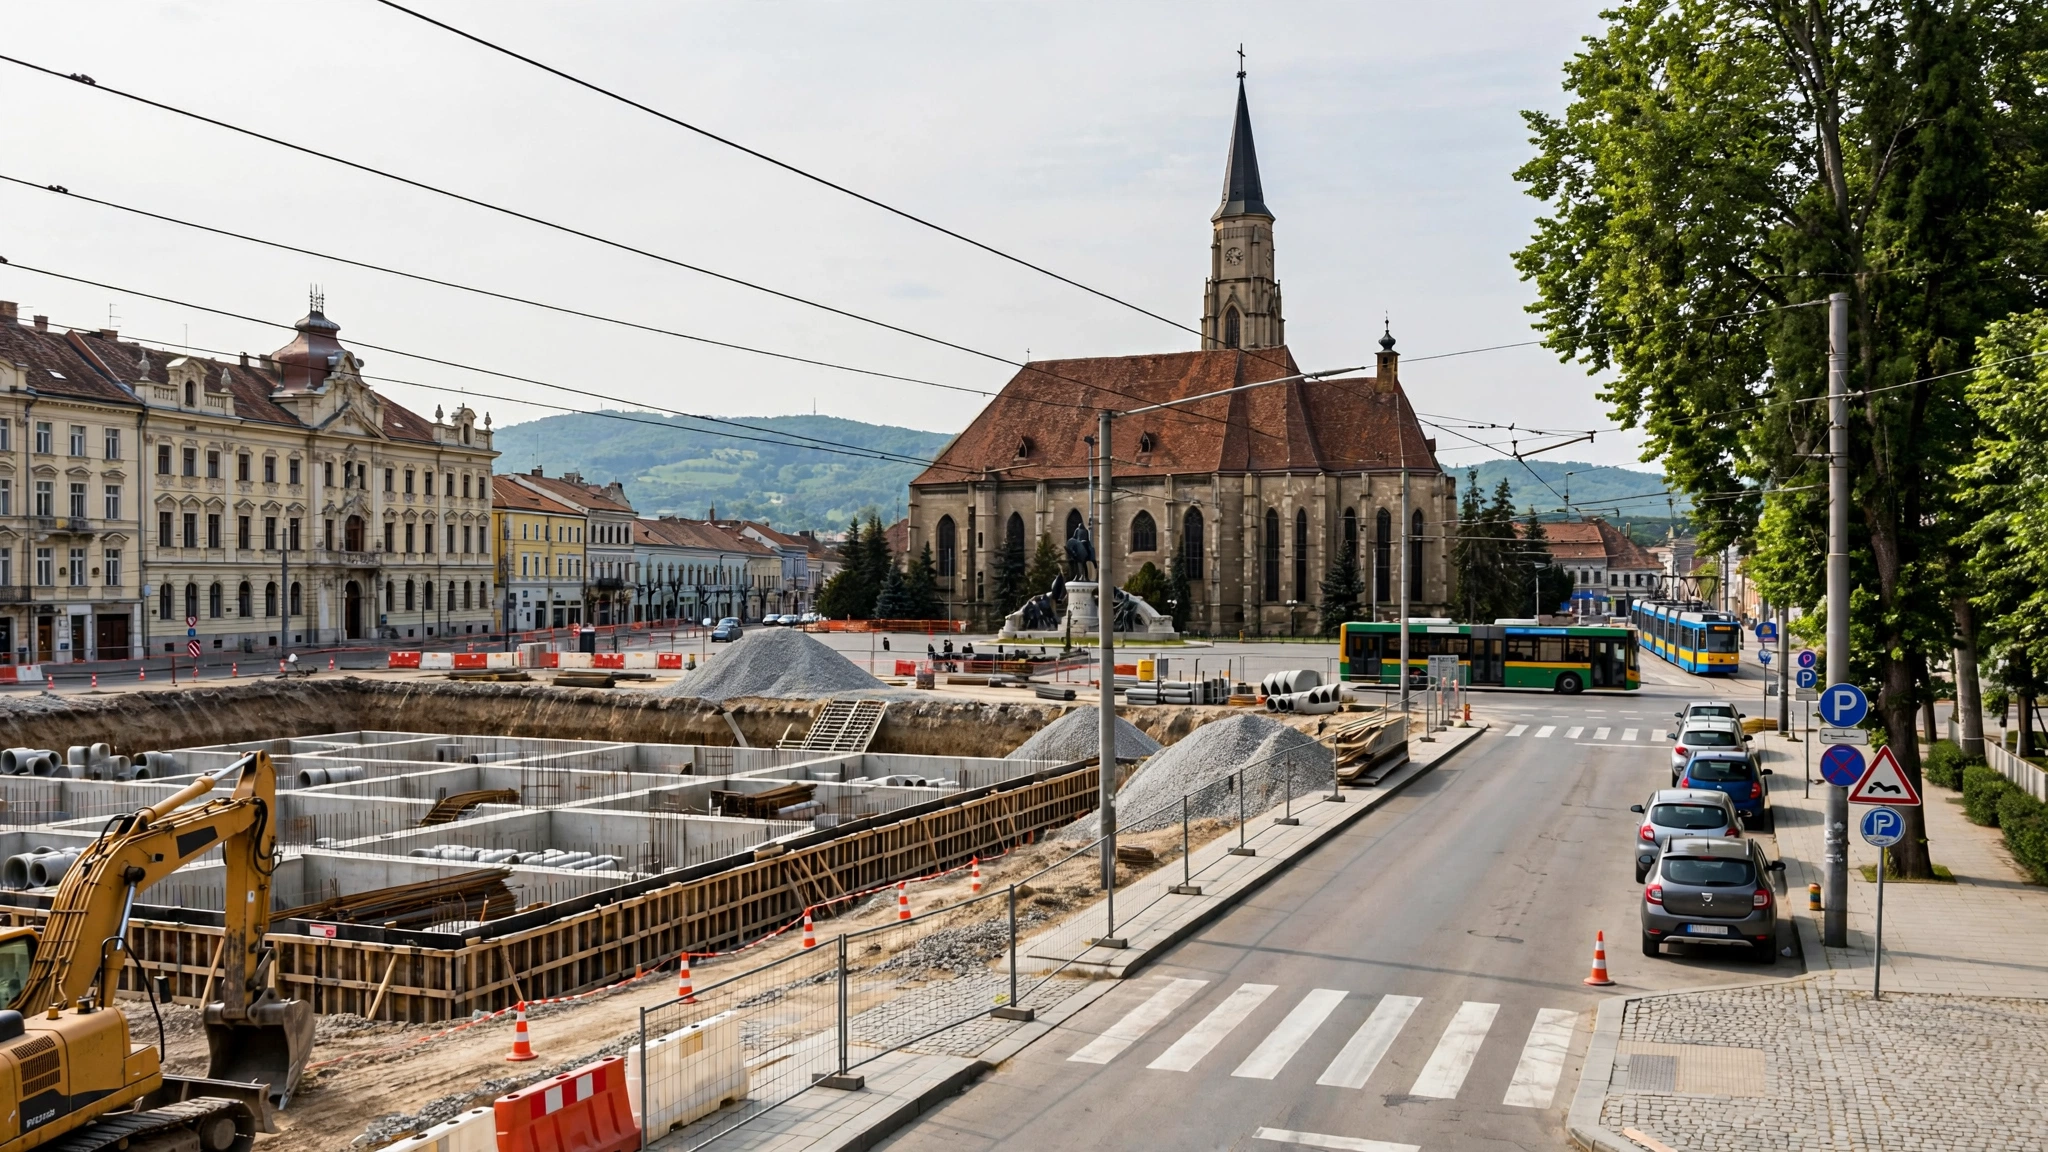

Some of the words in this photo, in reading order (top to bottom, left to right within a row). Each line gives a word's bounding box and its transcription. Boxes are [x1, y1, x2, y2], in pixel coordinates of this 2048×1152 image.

[1801, 671, 1812, 688] P
[1834, 690, 1857, 721] P
[1873, 811, 1894, 835] P
